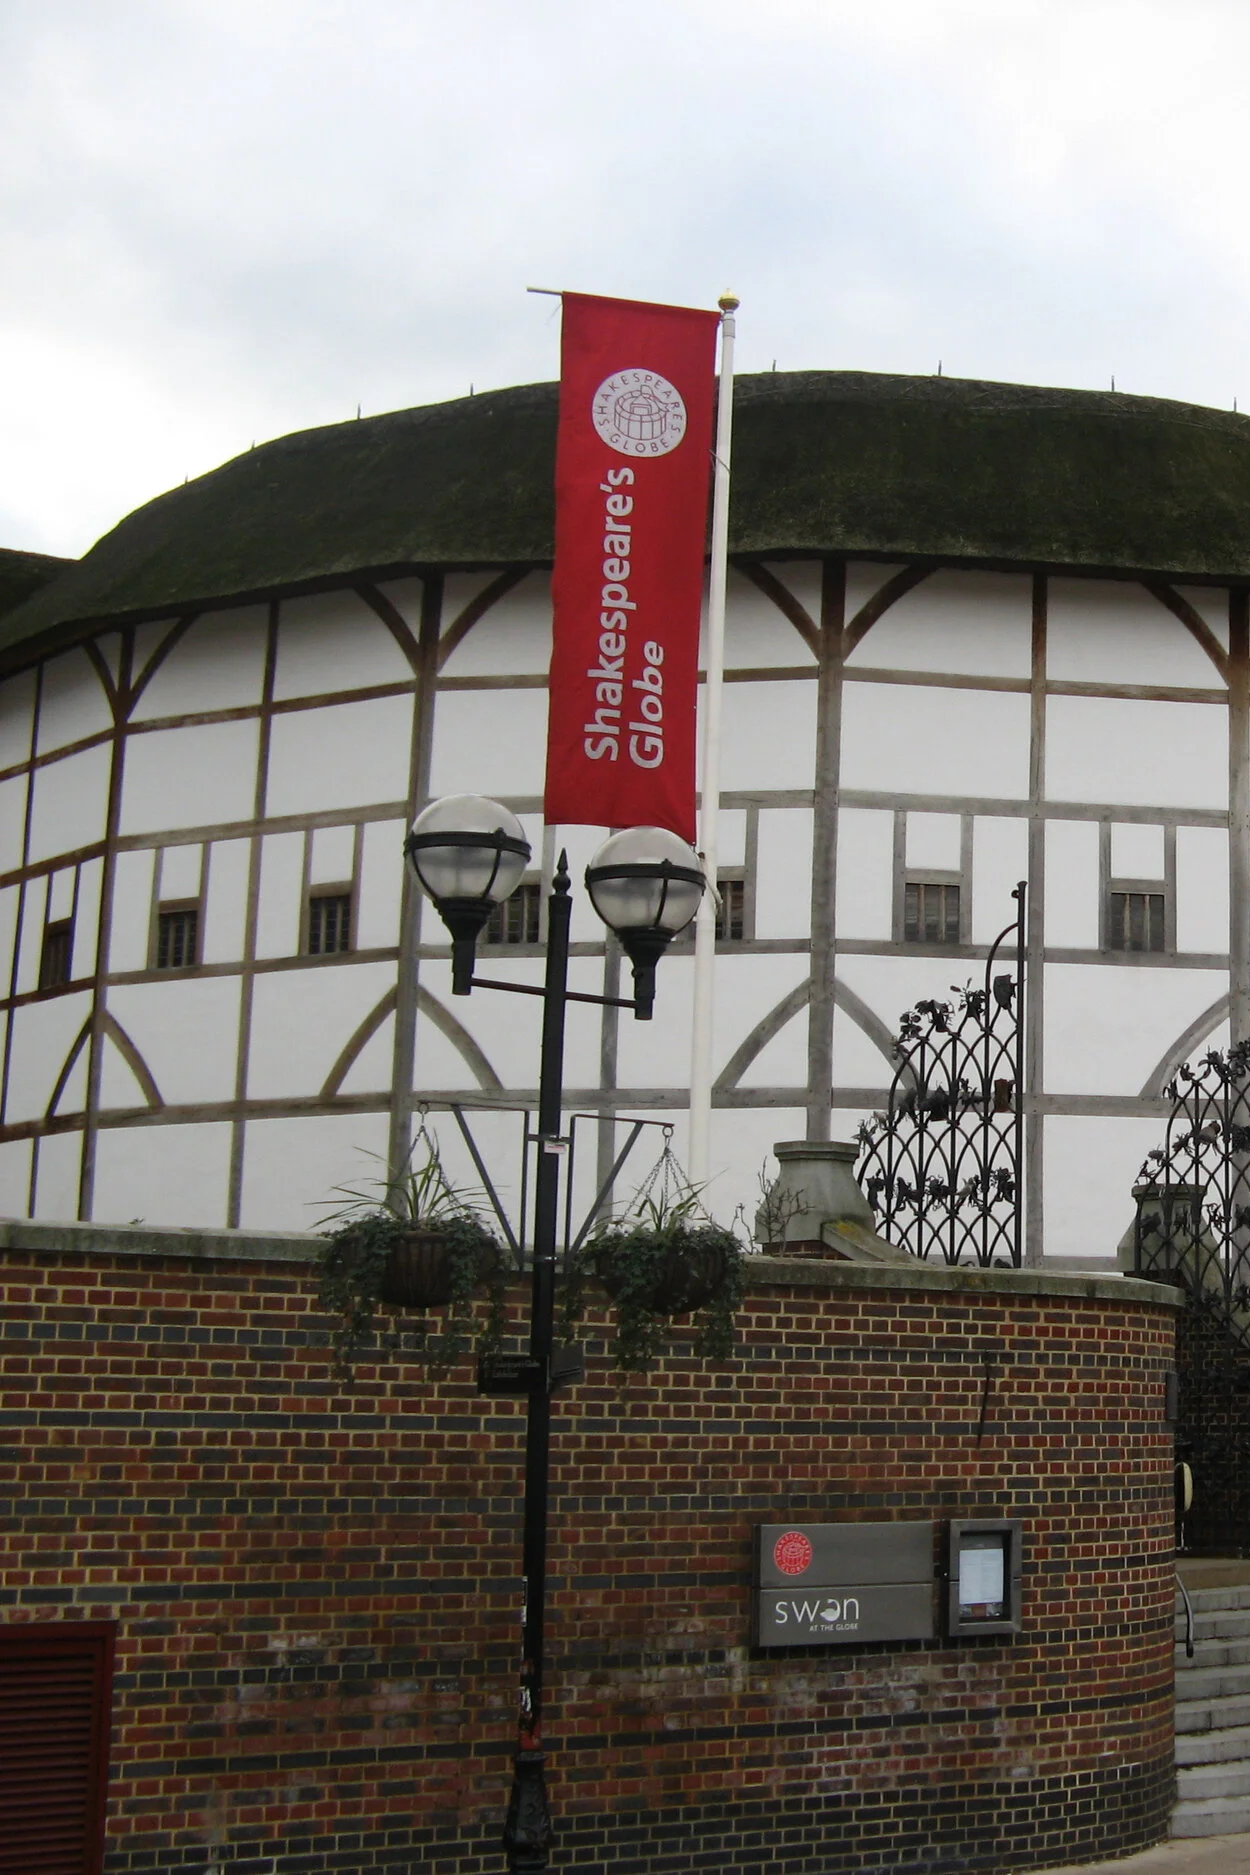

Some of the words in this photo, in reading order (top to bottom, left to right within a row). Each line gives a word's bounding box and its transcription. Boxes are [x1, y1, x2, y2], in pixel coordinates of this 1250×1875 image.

[609, 433, 669, 453] GLOBE
[584, 467, 637, 762] Shakespeare's
[629, 640, 664, 769] Globe
[820, 1624, 834, 1632] THE
[836, 1623, 858, 1631] GLOBE
